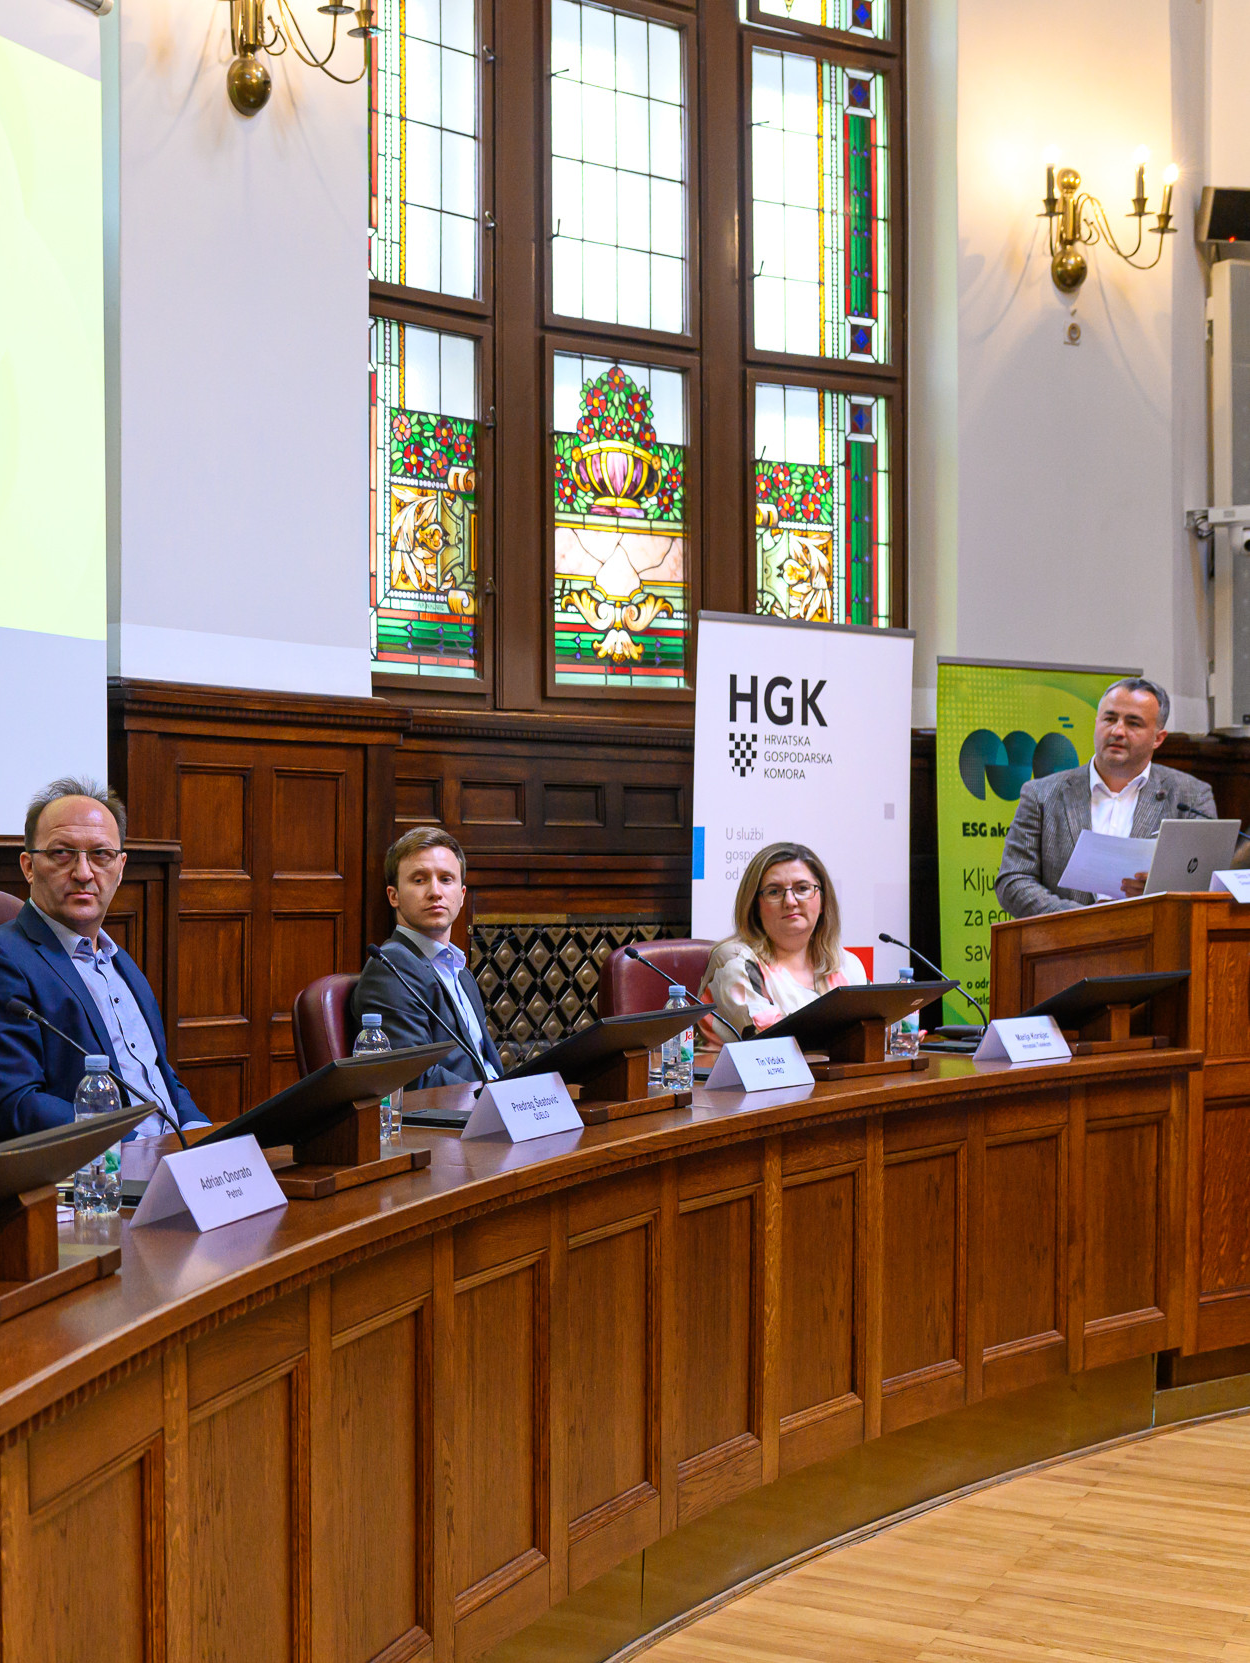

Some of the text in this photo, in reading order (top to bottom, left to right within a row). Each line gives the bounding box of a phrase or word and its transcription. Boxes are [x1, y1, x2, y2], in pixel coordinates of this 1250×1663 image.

[729, 674, 828, 727] HGK
[764, 734, 811, 747] HRVATSKA
[763, 751, 833, 765] GOSPODARSKA
[763, 768, 806, 780] KOMORA
[725, 827, 764, 841] U službi
[962, 822, 987, 837] ESG
[725, 848, 758, 864] gospo
[725, 866, 739, 880] od
[963, 867, 999, 896] Klju
[964, 910, 984, 926] za
[965, 945, 991, 962] sav
[967, 977, 990, 989] o odr
[756, 1057, 766, 1066] Tin
[511, 1100, 536, 1113] Predrag
[199, 1166, 253, 1191] Adrian Onorato
[226, 1187, 244, 1199] Petrol
